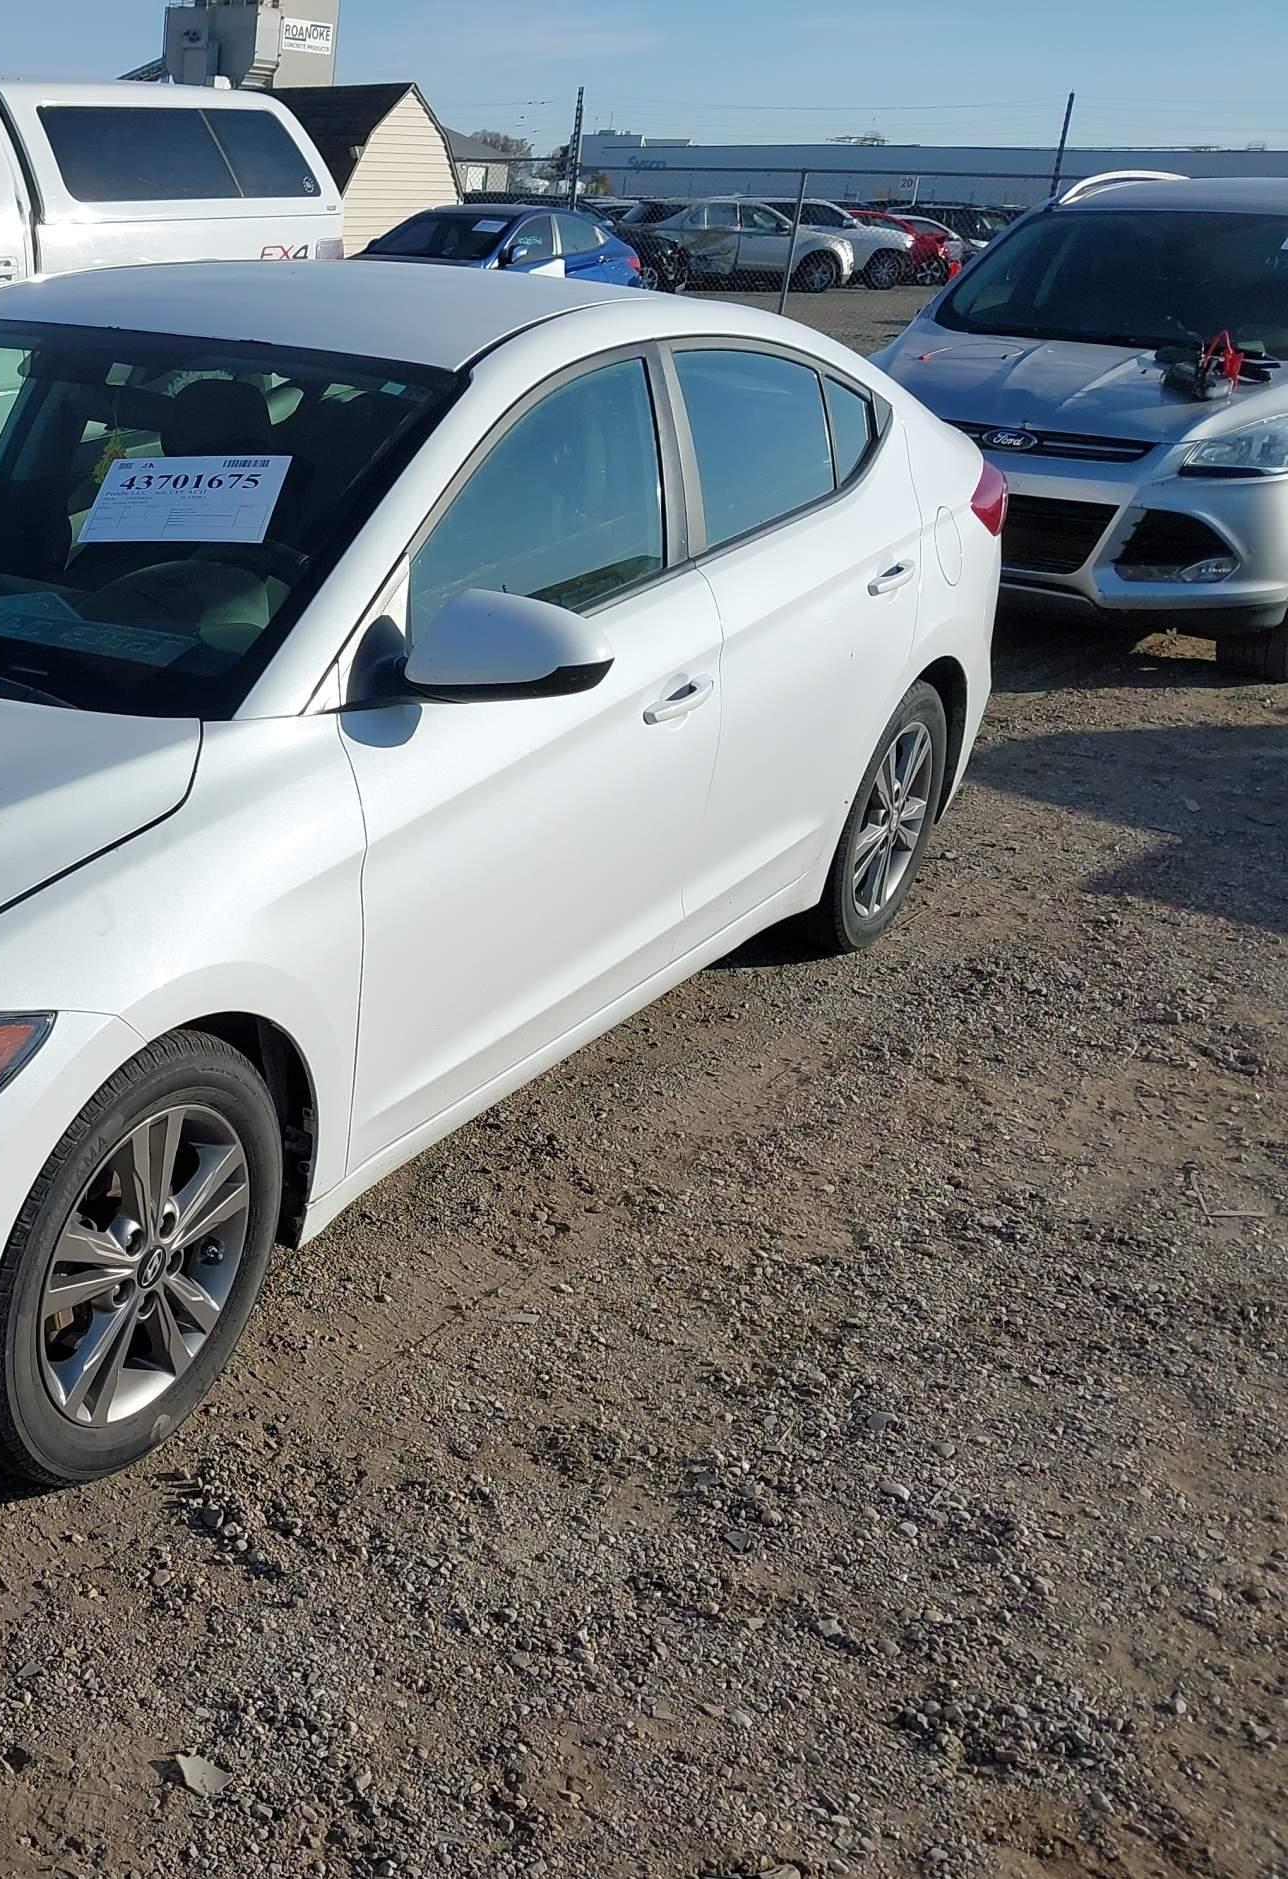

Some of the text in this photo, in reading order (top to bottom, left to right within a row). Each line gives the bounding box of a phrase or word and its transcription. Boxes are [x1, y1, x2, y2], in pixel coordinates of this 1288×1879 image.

[285, 24, 331, 41] ROANOKE
[901, 178, 914, 188] 20
[260, 244, 309, 260] FX4
[993, 431, 1025, 446] Ford
[119, 473, 262, 490] 43701675
